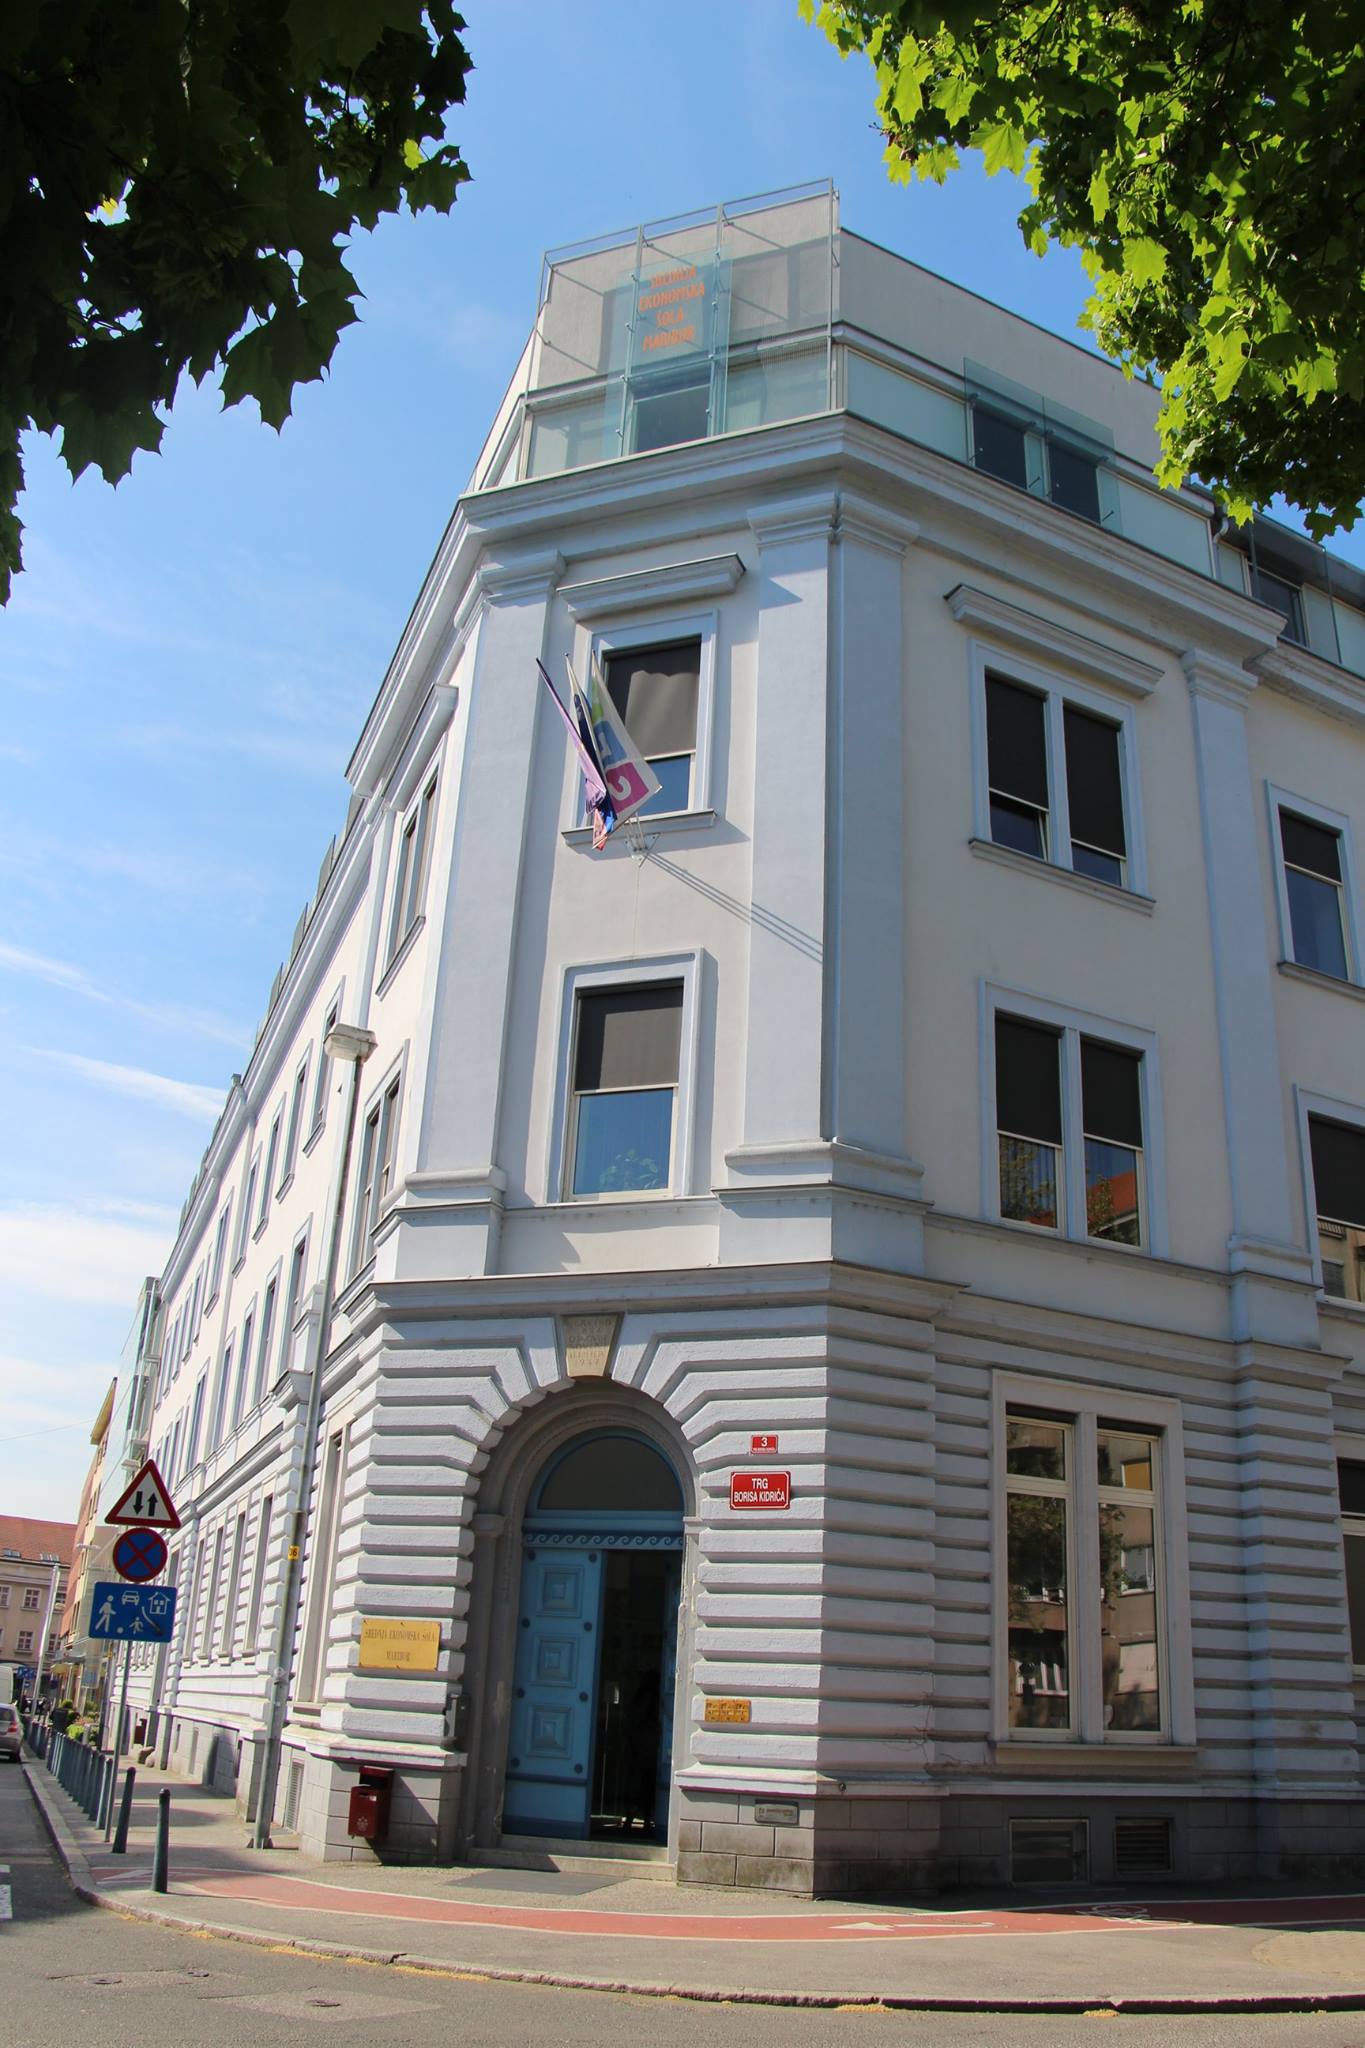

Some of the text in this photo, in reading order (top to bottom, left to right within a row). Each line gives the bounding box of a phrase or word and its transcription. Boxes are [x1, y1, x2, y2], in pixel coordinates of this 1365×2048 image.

[760, 1437, 768, 1447] 3
[752, 1478, 768, 1489] TRG
[734, 1491, 758, 1503] BORISA
